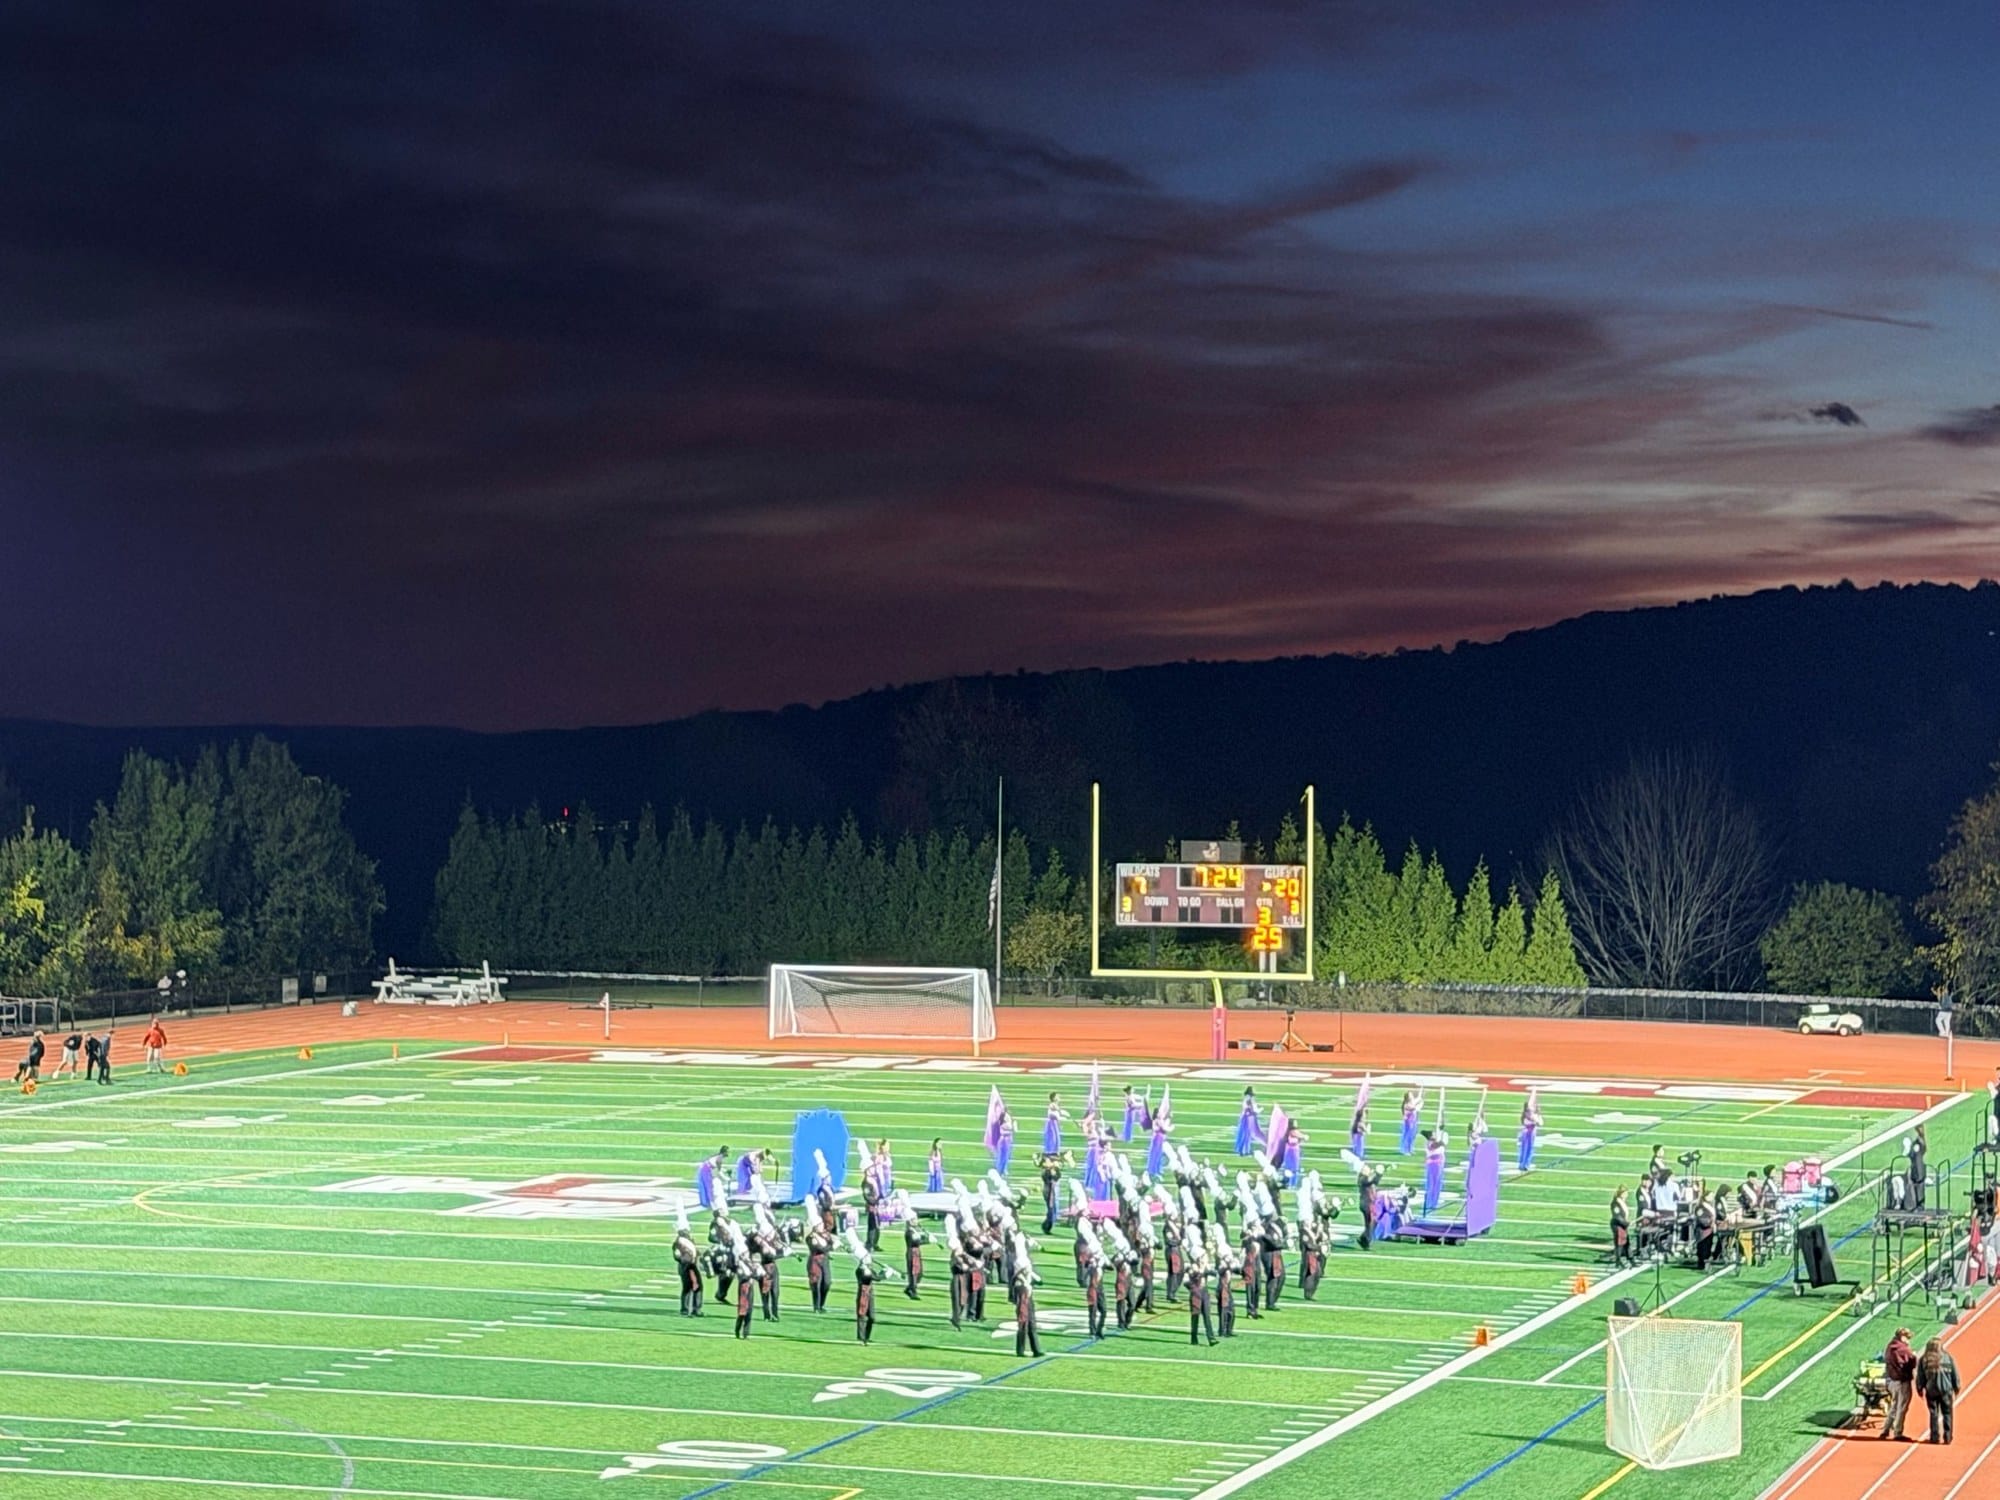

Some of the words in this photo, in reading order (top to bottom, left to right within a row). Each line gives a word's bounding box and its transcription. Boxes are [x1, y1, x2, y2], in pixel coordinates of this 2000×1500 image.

[1119, 866, 1160, 877] WILDCATS
[1195, 865, 1242, 888] 7:24
[1134, 876, 1147, 895] 7
[1275, 879, 1299, 897] 20
[1122, 896, 1132, 913] 3
[1144, 896, 1168, 906] DOWN
[1177, 897, 1188, 907] TO
[1189, 897, 1201, 907] GO
[1216, 897, 1233, 907] BALL
[1234, 897, 1245, 907] ON
[1258, 906, 1271, 925] 3
[1252, 927, 1282, 950] 25
[589, 1051, 1810, 1101] WILDCATS
[824, 1368, 982, 1399] 20
[622, 1439, 788, 1470] 10
